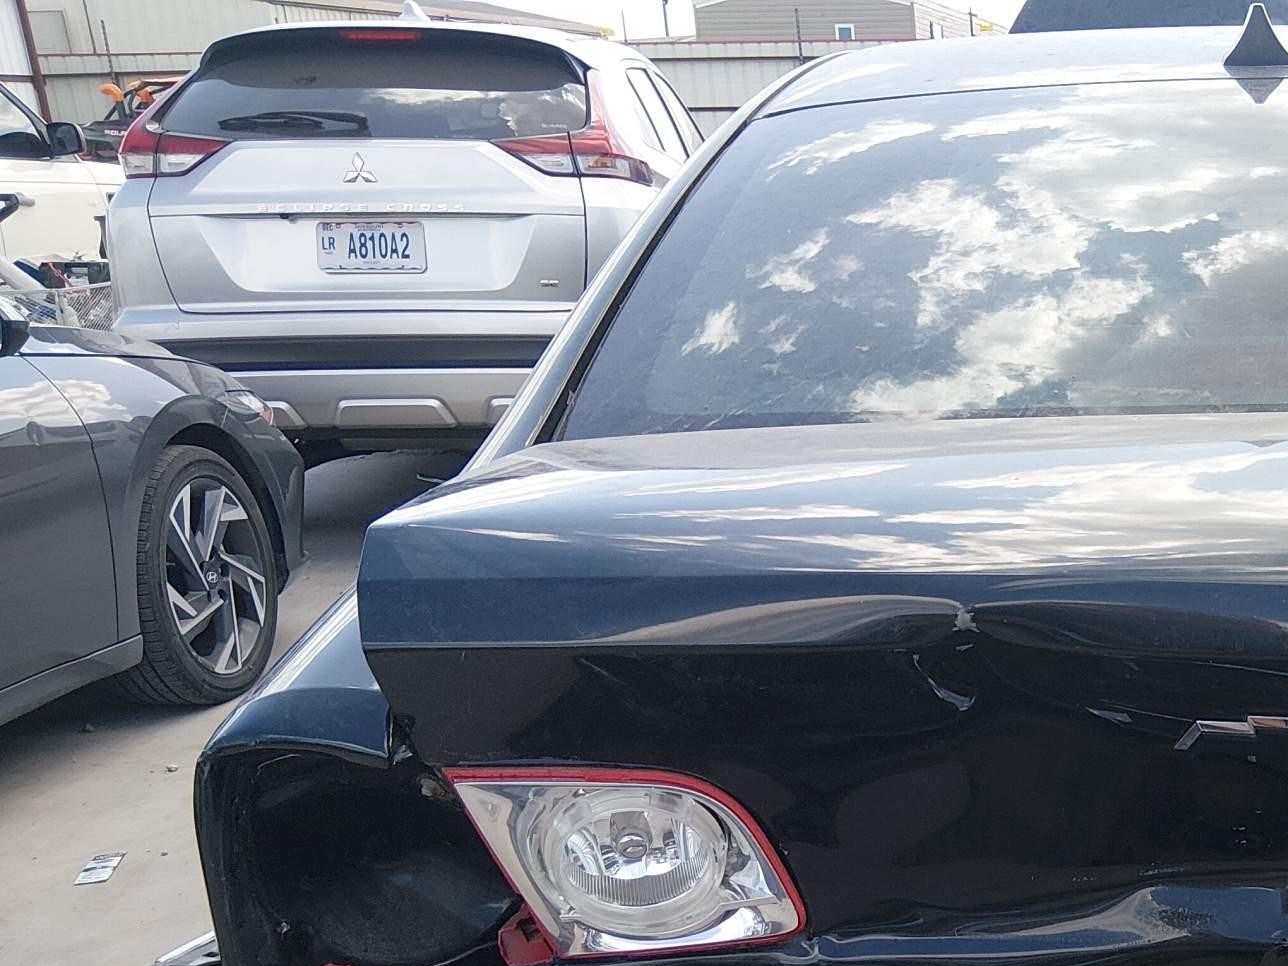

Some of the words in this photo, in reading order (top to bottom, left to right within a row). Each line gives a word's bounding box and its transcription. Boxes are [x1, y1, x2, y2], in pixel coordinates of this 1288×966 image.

[257, 203, 369, 213] ECLIPSE
[385, 203, 466, 212] CROSS
[321, 236, 336, 251] LR
[347, 232, 411, 260] A810A2
